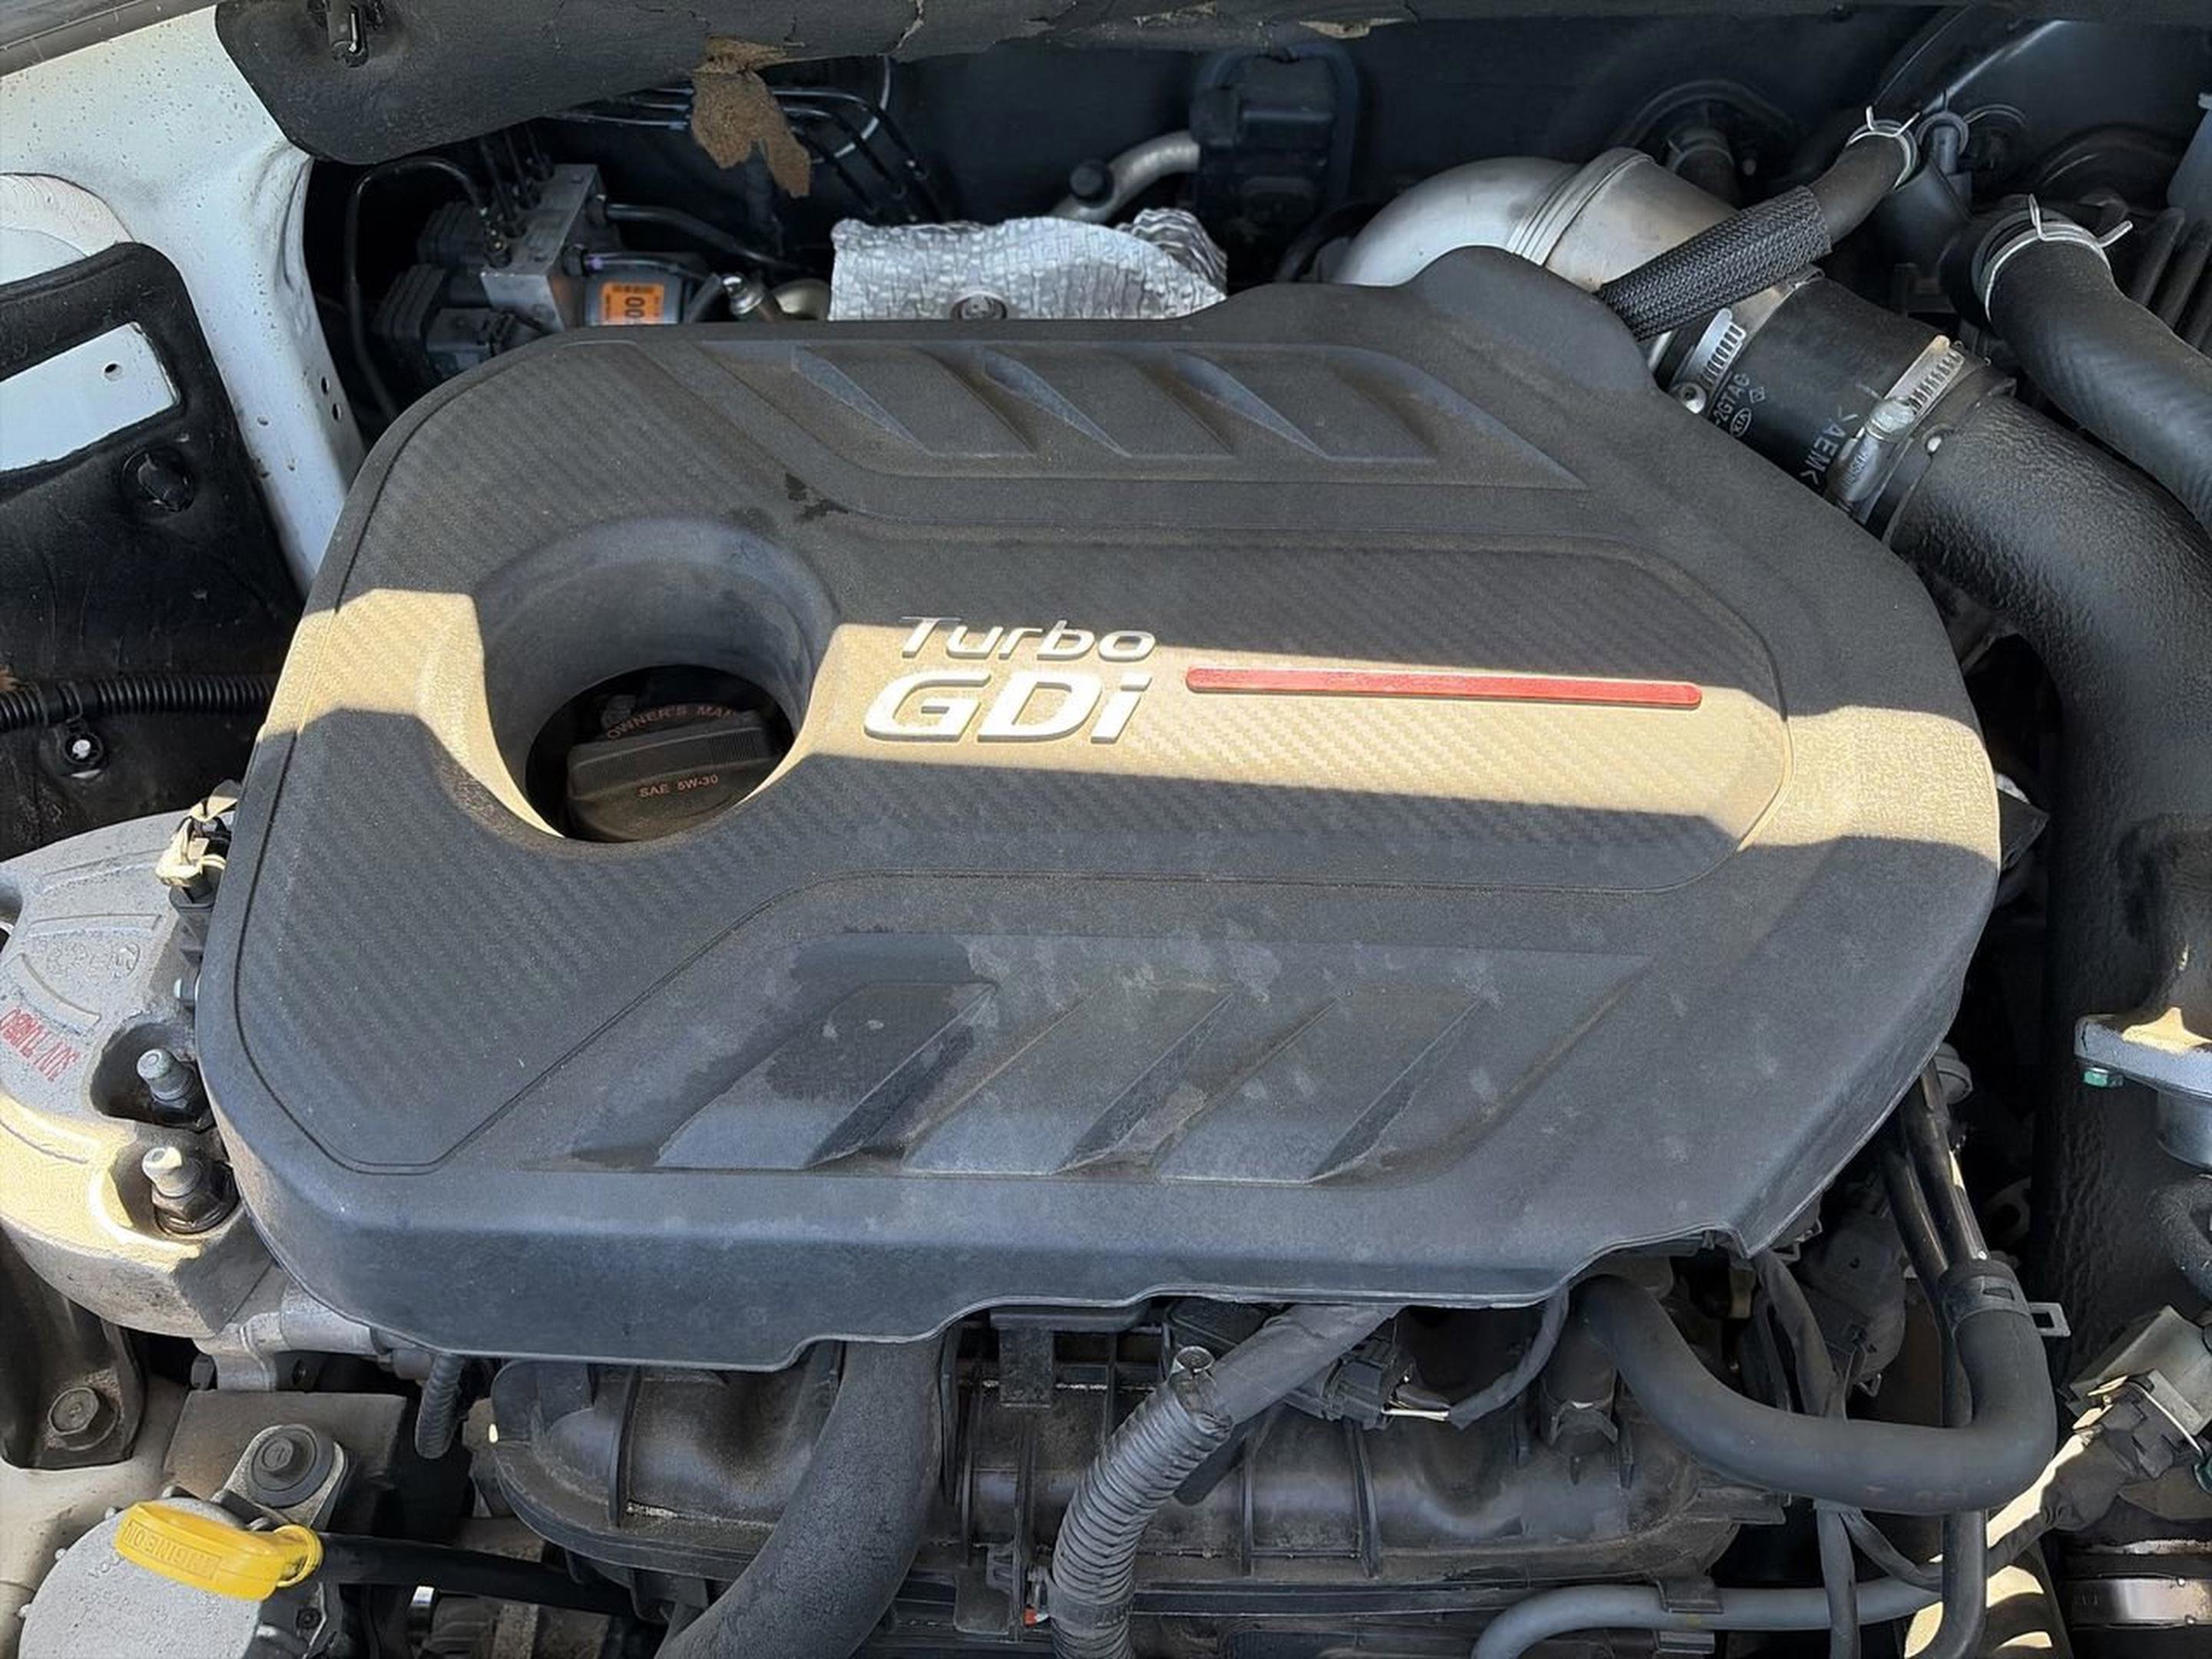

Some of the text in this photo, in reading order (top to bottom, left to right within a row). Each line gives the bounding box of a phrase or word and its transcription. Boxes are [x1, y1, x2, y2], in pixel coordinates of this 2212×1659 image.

[1730, 410, 1750, 436] KIA
[899, 617, 1156, 663] Turbo
[864, 671, 1152, 744] GDi
[638, 773, 720, 798] SAE 5W-30
